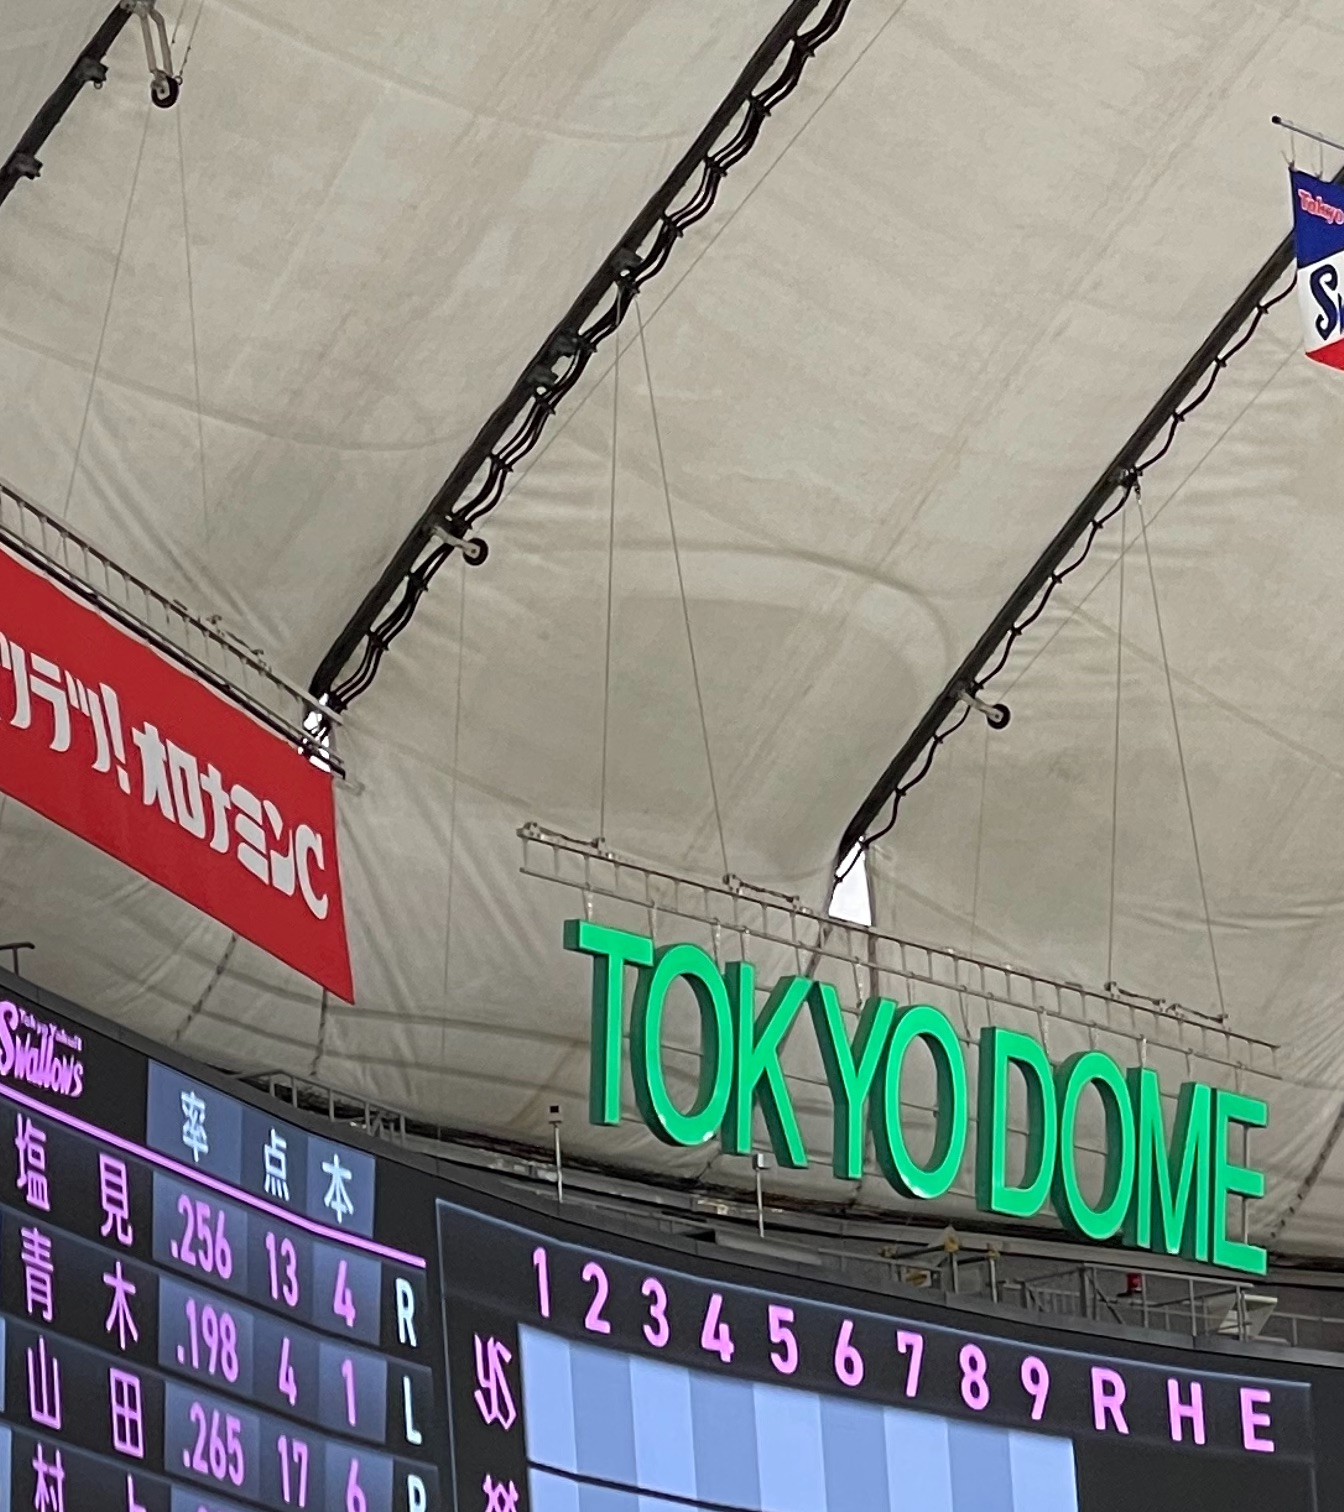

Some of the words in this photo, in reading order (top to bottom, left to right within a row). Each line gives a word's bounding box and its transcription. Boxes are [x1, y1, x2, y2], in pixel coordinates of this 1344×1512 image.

[180, 1090, 210, 1163] 率
[262, 1127, 290, 1201] 点
[320, 1153, 354, 1224] 本
[563, 918, 968, 1201] TOKYO
[975, 1025, 1268, 1276] DOME
[170, 1194, 233, 1280] .256
[264, 1231, 299, 1308] 13
[176, 1297, 239, 1383] .198
[531, 1246, 551, 1318] 1
[581, 1261, 611, 1334] 2
[641, 1277, 671, 1348] 3
[700, 1293, 735, 1363] 4
[768, 1304, 798, 1375] 5
[834, 1319, 865, 1387] 6
[896, 1330, 925, 1398] 7
[958, 1343, 990, 1411] 8
[1020, 1355, 1050, 1421] 9
[1090, 1365, 1130, 1435] R
[1167, 1377, 1207, 1446] H
[1239, 1386, 1276, 1453] E
[183, 1401, 246, 1487] .265
[277, 1434, 309, 1509] 17
